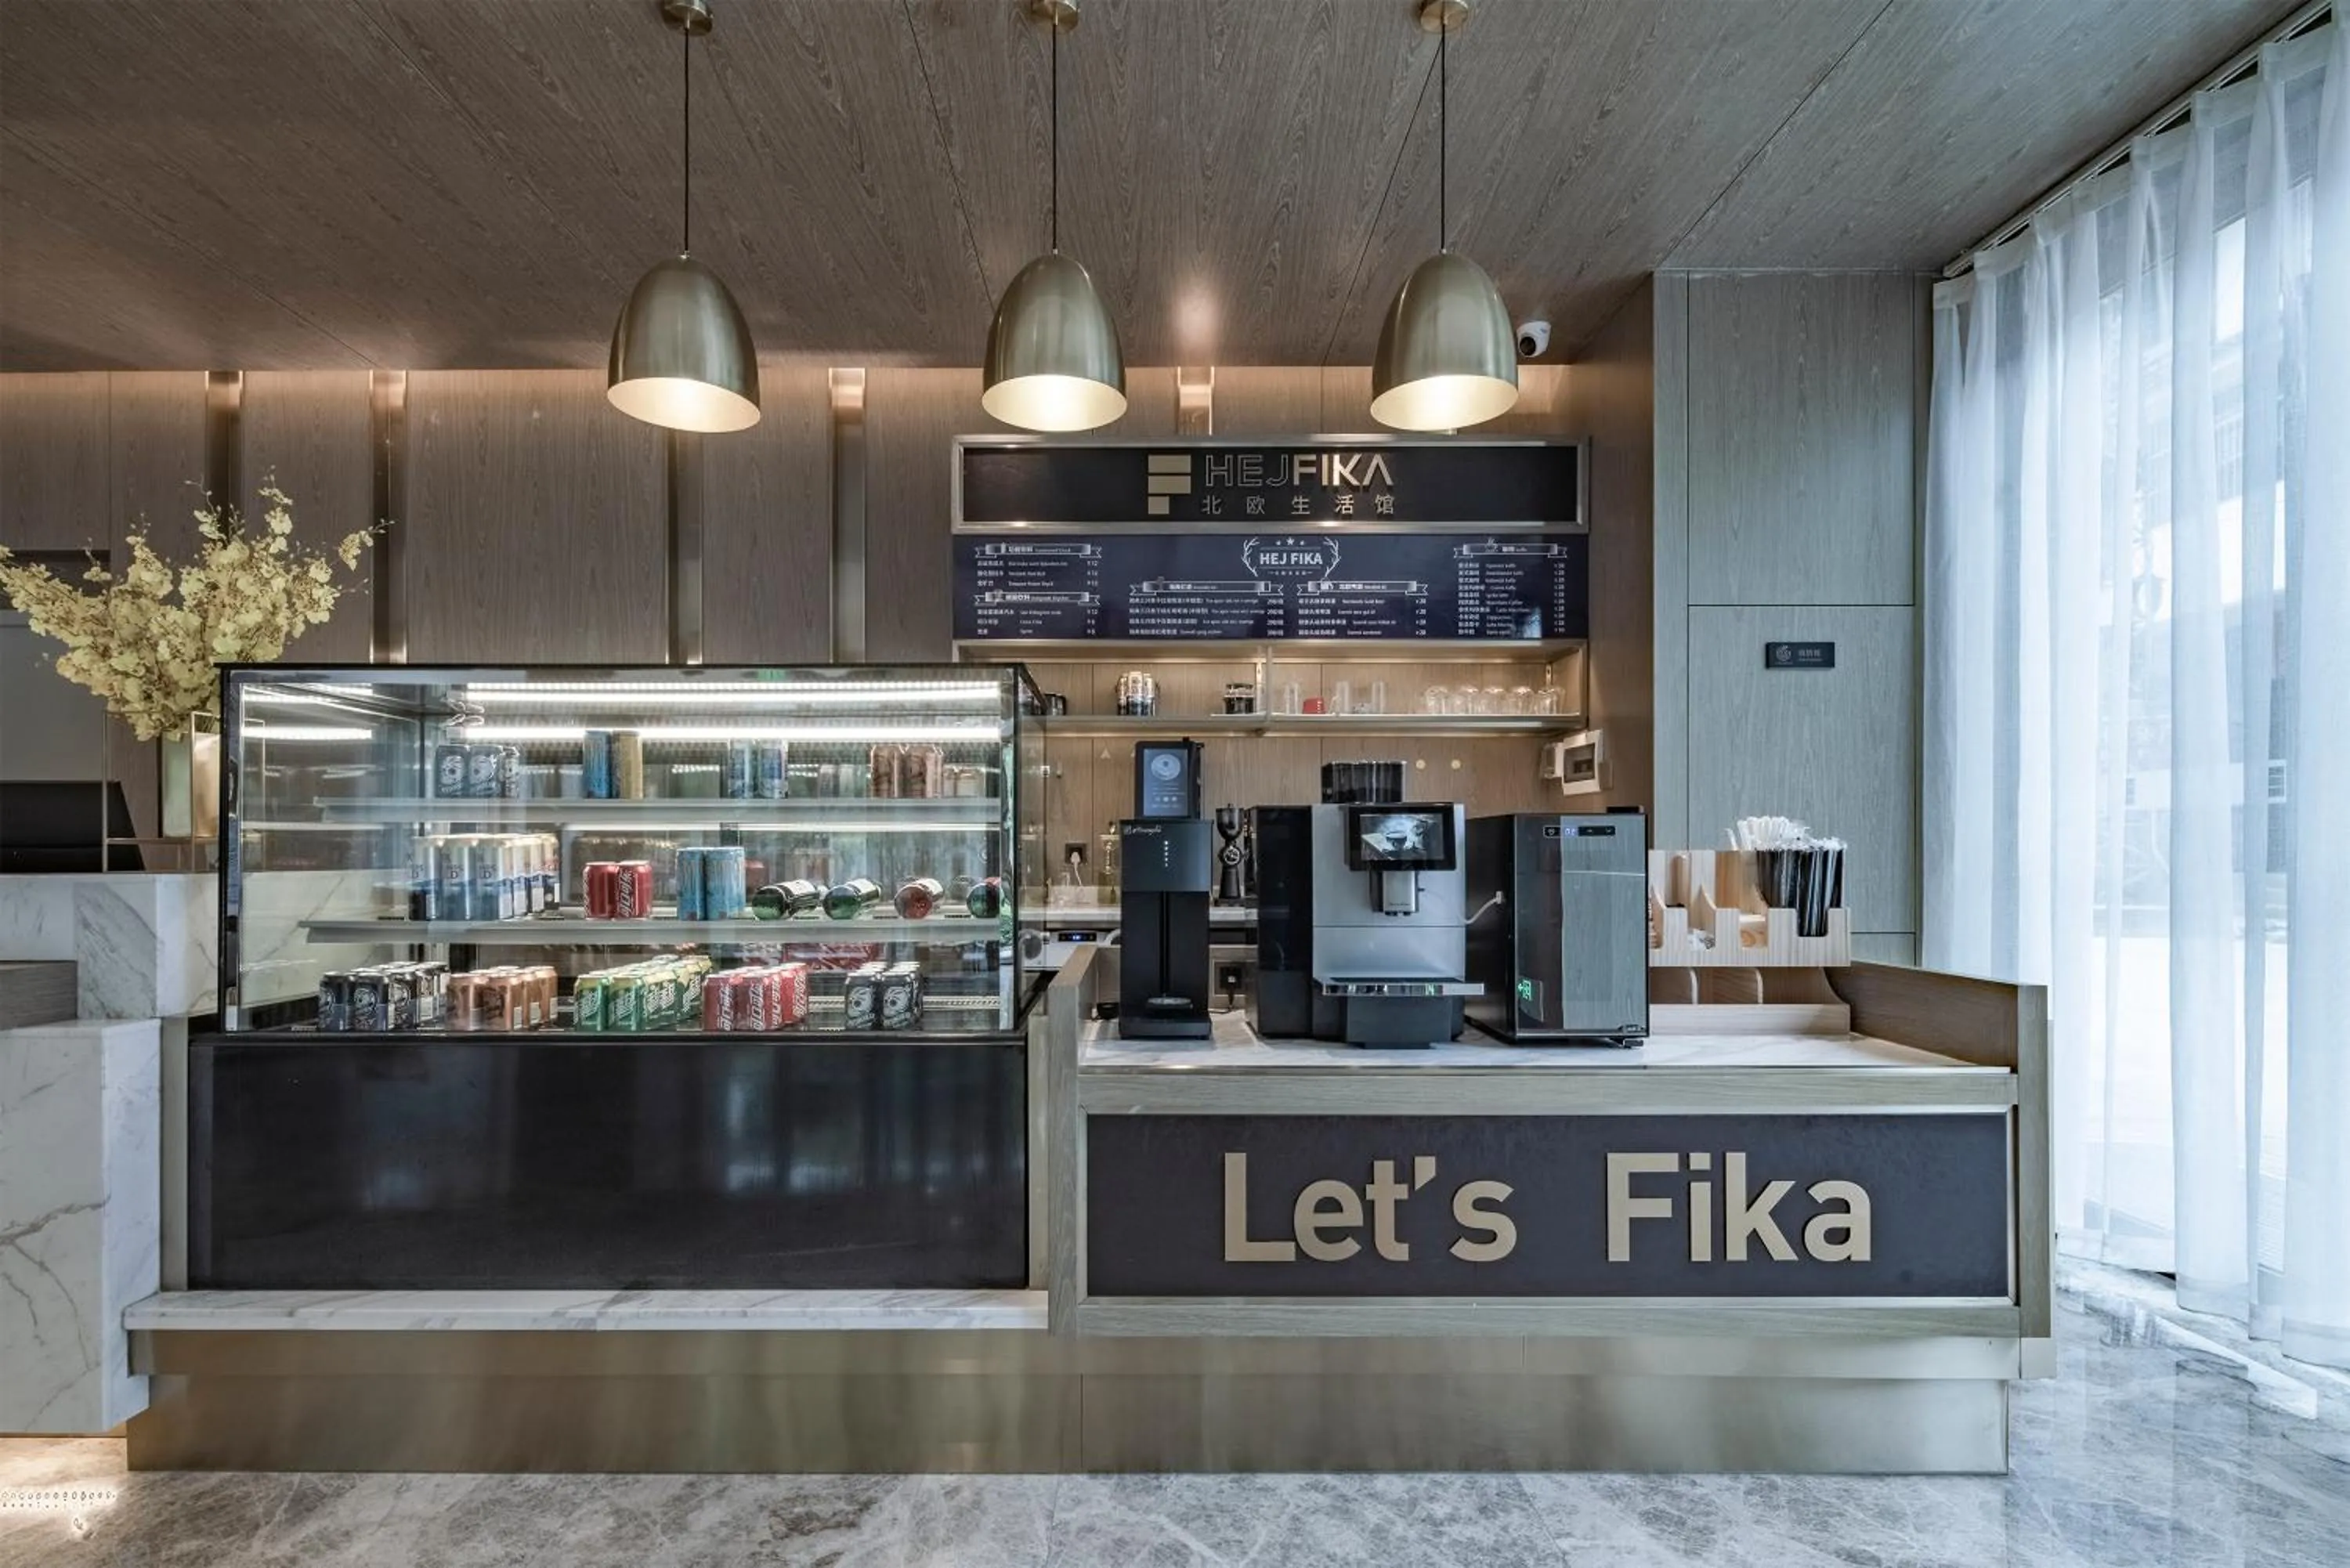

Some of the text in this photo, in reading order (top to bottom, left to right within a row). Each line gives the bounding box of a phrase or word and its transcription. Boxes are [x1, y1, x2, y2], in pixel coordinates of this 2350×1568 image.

[1202, 494, 1394, 515] 北欧生活馆
[1259, 552, 1324, 565] HEJ FIKA
[1224, 1151, 1873, 1262] Let's Fika
